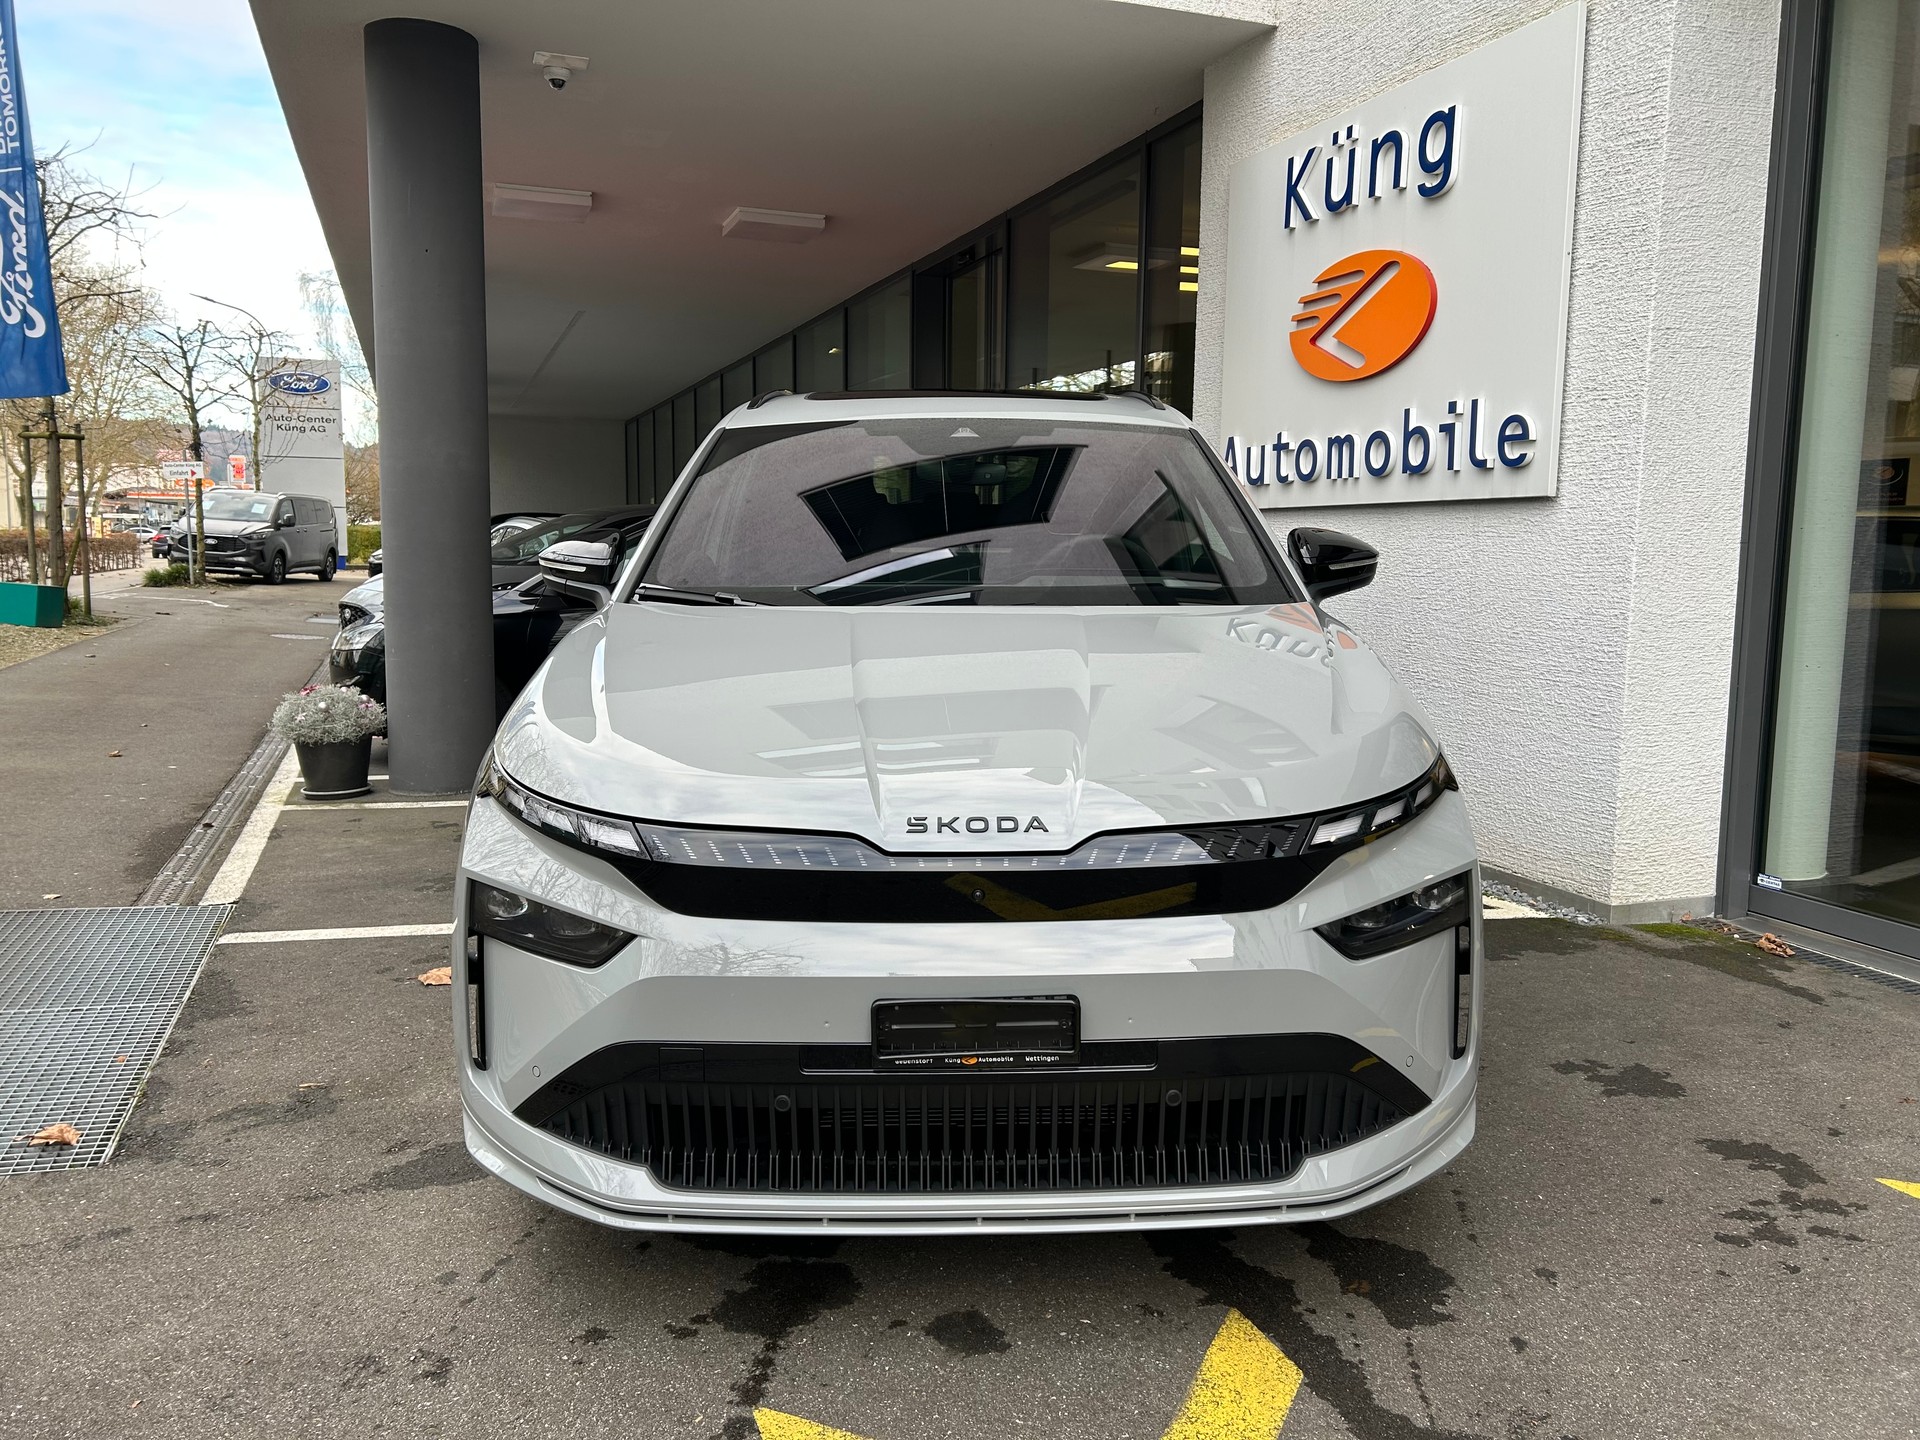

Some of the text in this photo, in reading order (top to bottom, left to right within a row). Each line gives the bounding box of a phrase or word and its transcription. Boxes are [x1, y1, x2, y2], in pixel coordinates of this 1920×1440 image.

[1284, 105, 1460, 230] Küng
[280, 374, 319, 390] Ford
[265, 413, 337, 424] Auto-Center
[276, 423, 327, 434] Küng AG
[1225, 398, 1537, 486] Automobile
[906, 816, 1049, 834] SKODA
[978, 1055, 1014, 1063] Automobile
